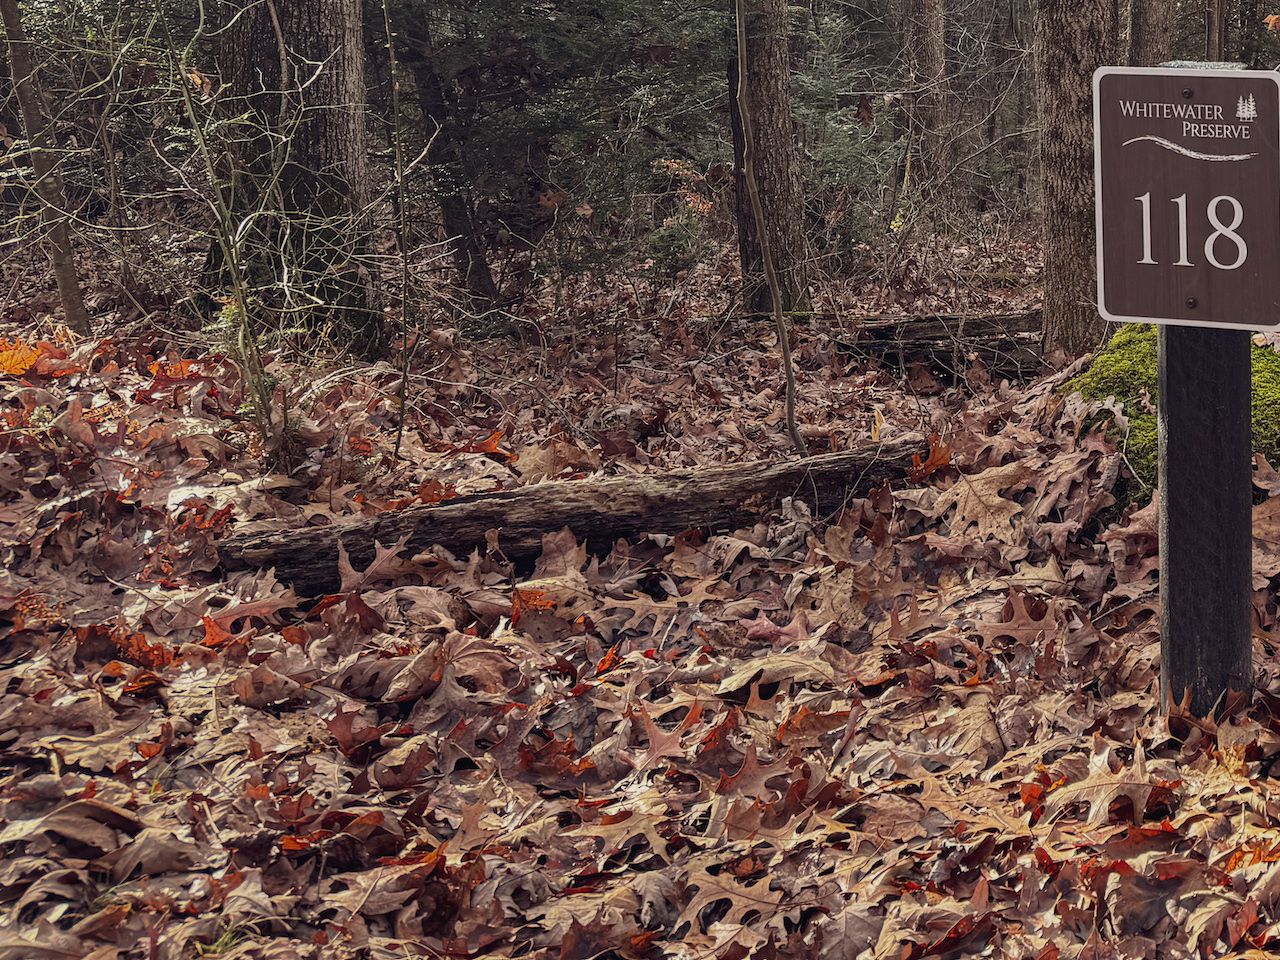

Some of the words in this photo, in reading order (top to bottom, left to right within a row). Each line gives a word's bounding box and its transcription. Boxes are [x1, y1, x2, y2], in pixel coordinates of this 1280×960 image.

[1119, 100, 1224, 120] WHITEWATER
[1182, 121, 1250, 139] PRESERVE
[1134, 191, 1248, 270] 118
